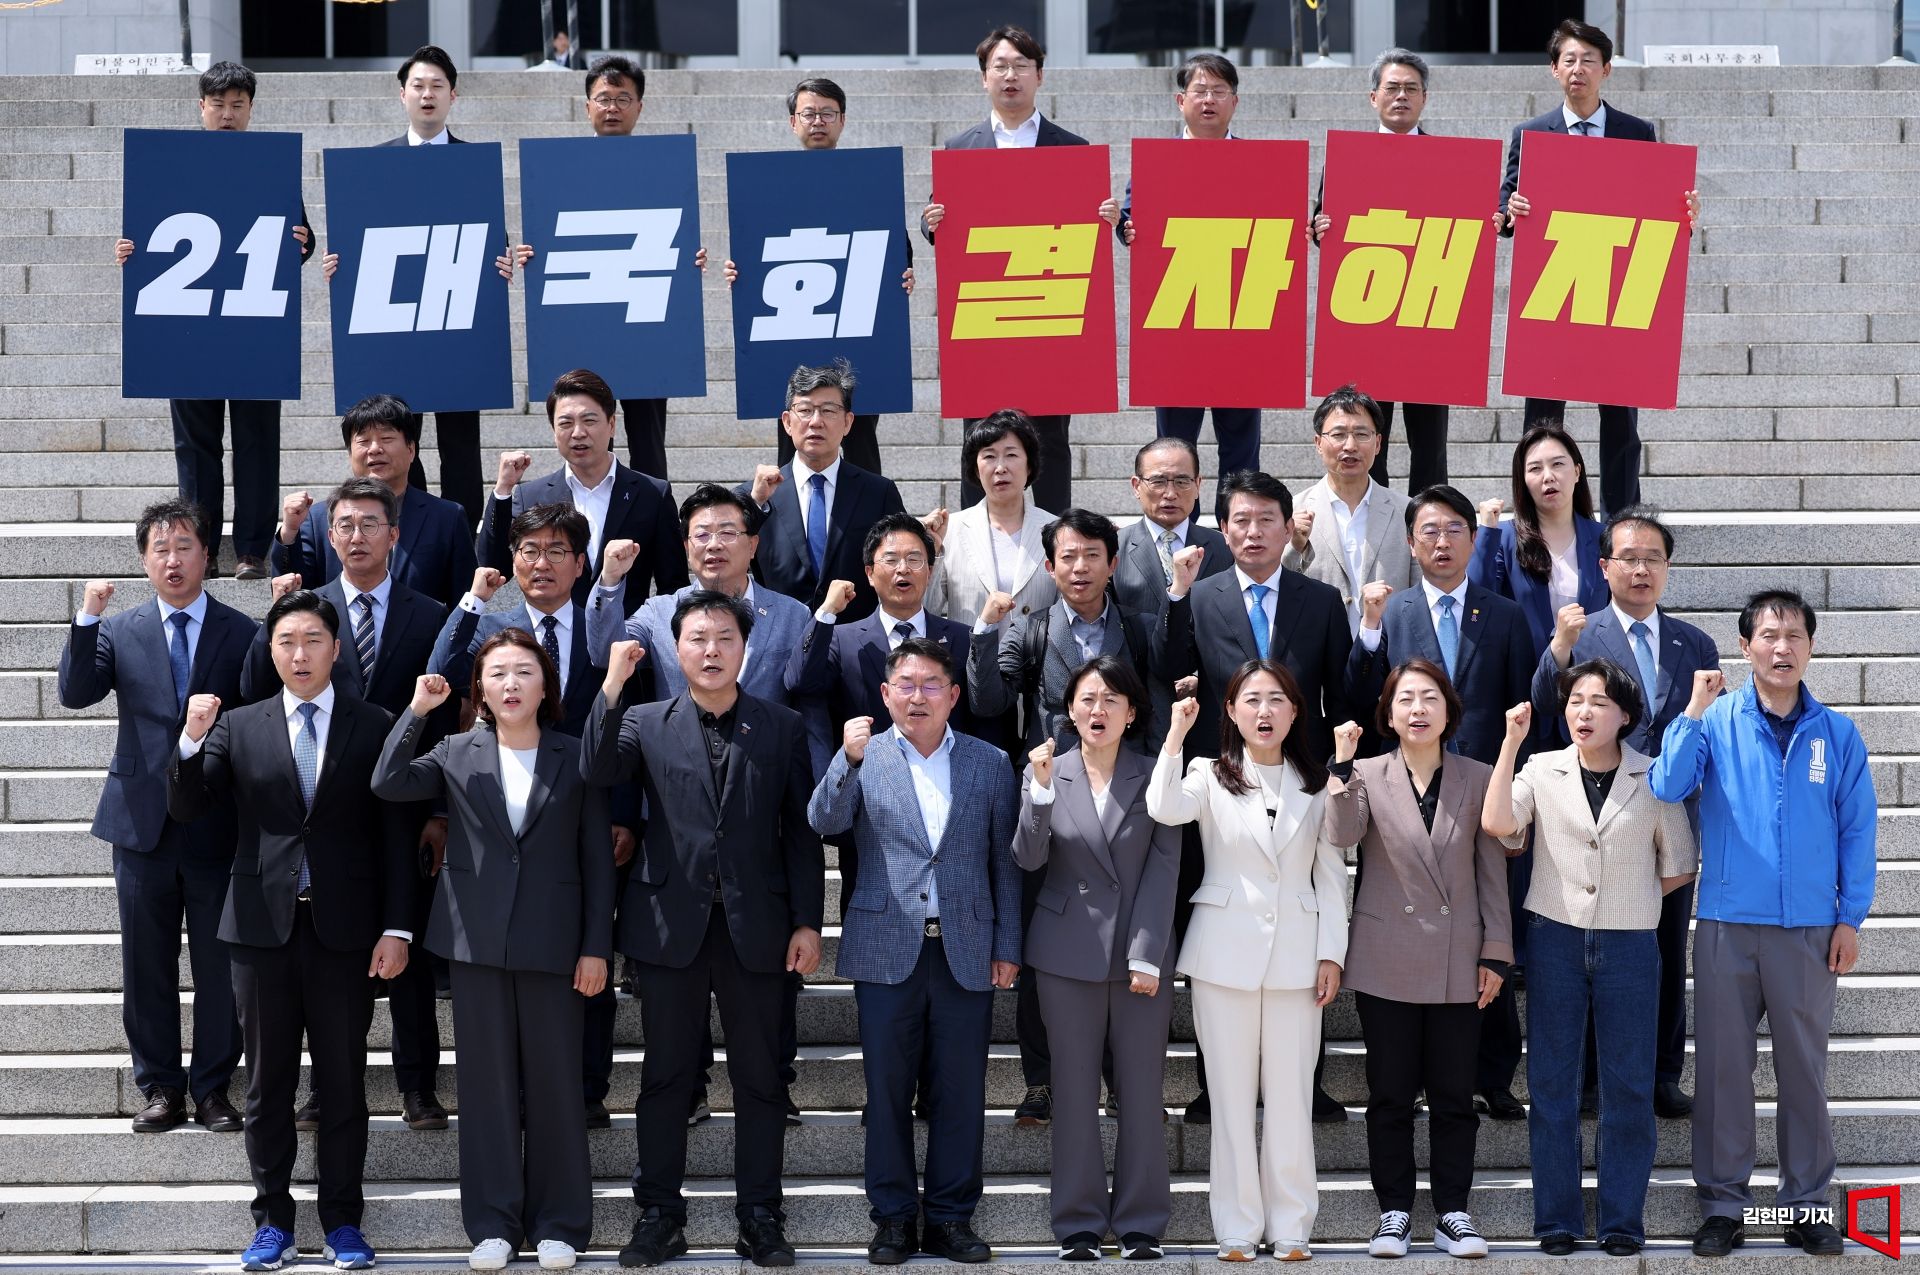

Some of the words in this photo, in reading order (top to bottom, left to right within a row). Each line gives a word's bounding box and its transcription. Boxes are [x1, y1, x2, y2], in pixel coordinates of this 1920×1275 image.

[94, 57, 187, 67] 더불어민주
[135, 213, 289, 317] 21
[348, 223, 490, 334] 대
[541, 208, 682, 323] 국
[750, 227, 888, 341] 회
[952, 223, 1100, 338] 결
[1144, 218, 1294, 330] 자
[1330, 208, 1483, 330] 해
[1521, 211, 1679, 330] 지
[1810, 738, 1826, 770] 1
